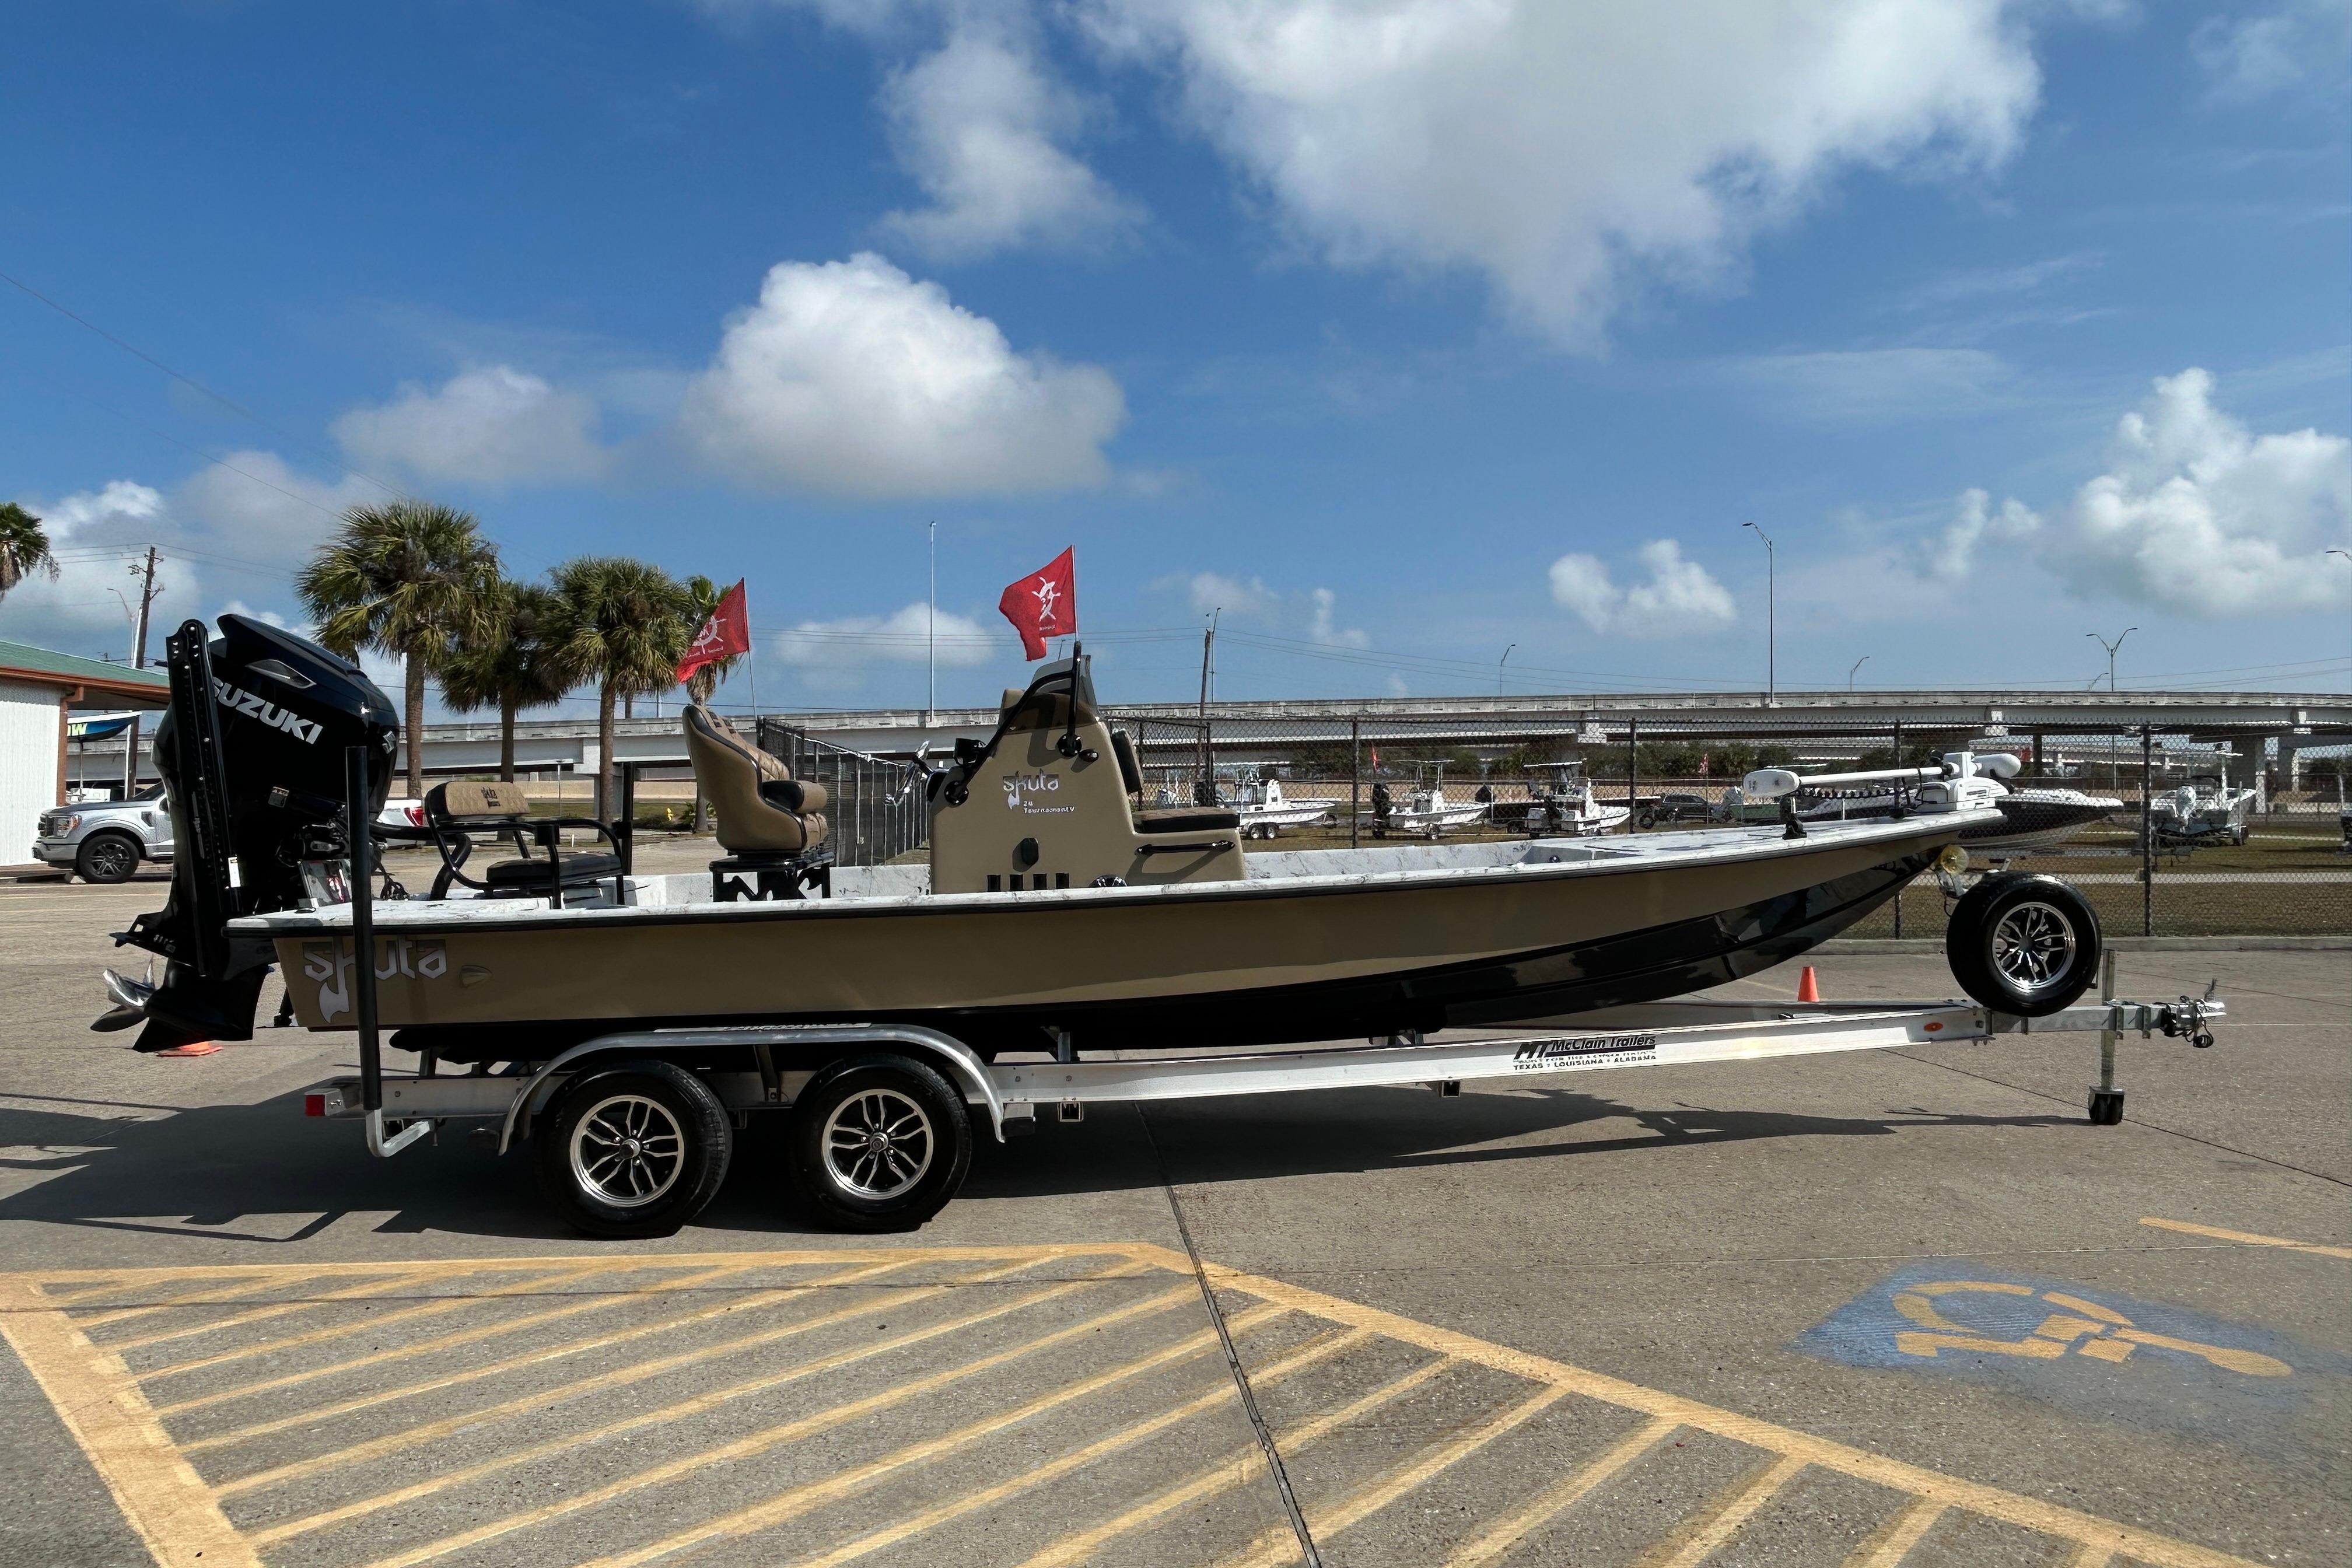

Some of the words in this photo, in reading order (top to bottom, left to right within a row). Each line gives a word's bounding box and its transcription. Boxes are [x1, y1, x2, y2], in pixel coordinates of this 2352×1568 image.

[1551, 1039, 1606, 1051] McClain
[1609, 1035, 1657, 1047] Trailers
[1554, 1059, 1604, 1068] LOUISIANA
